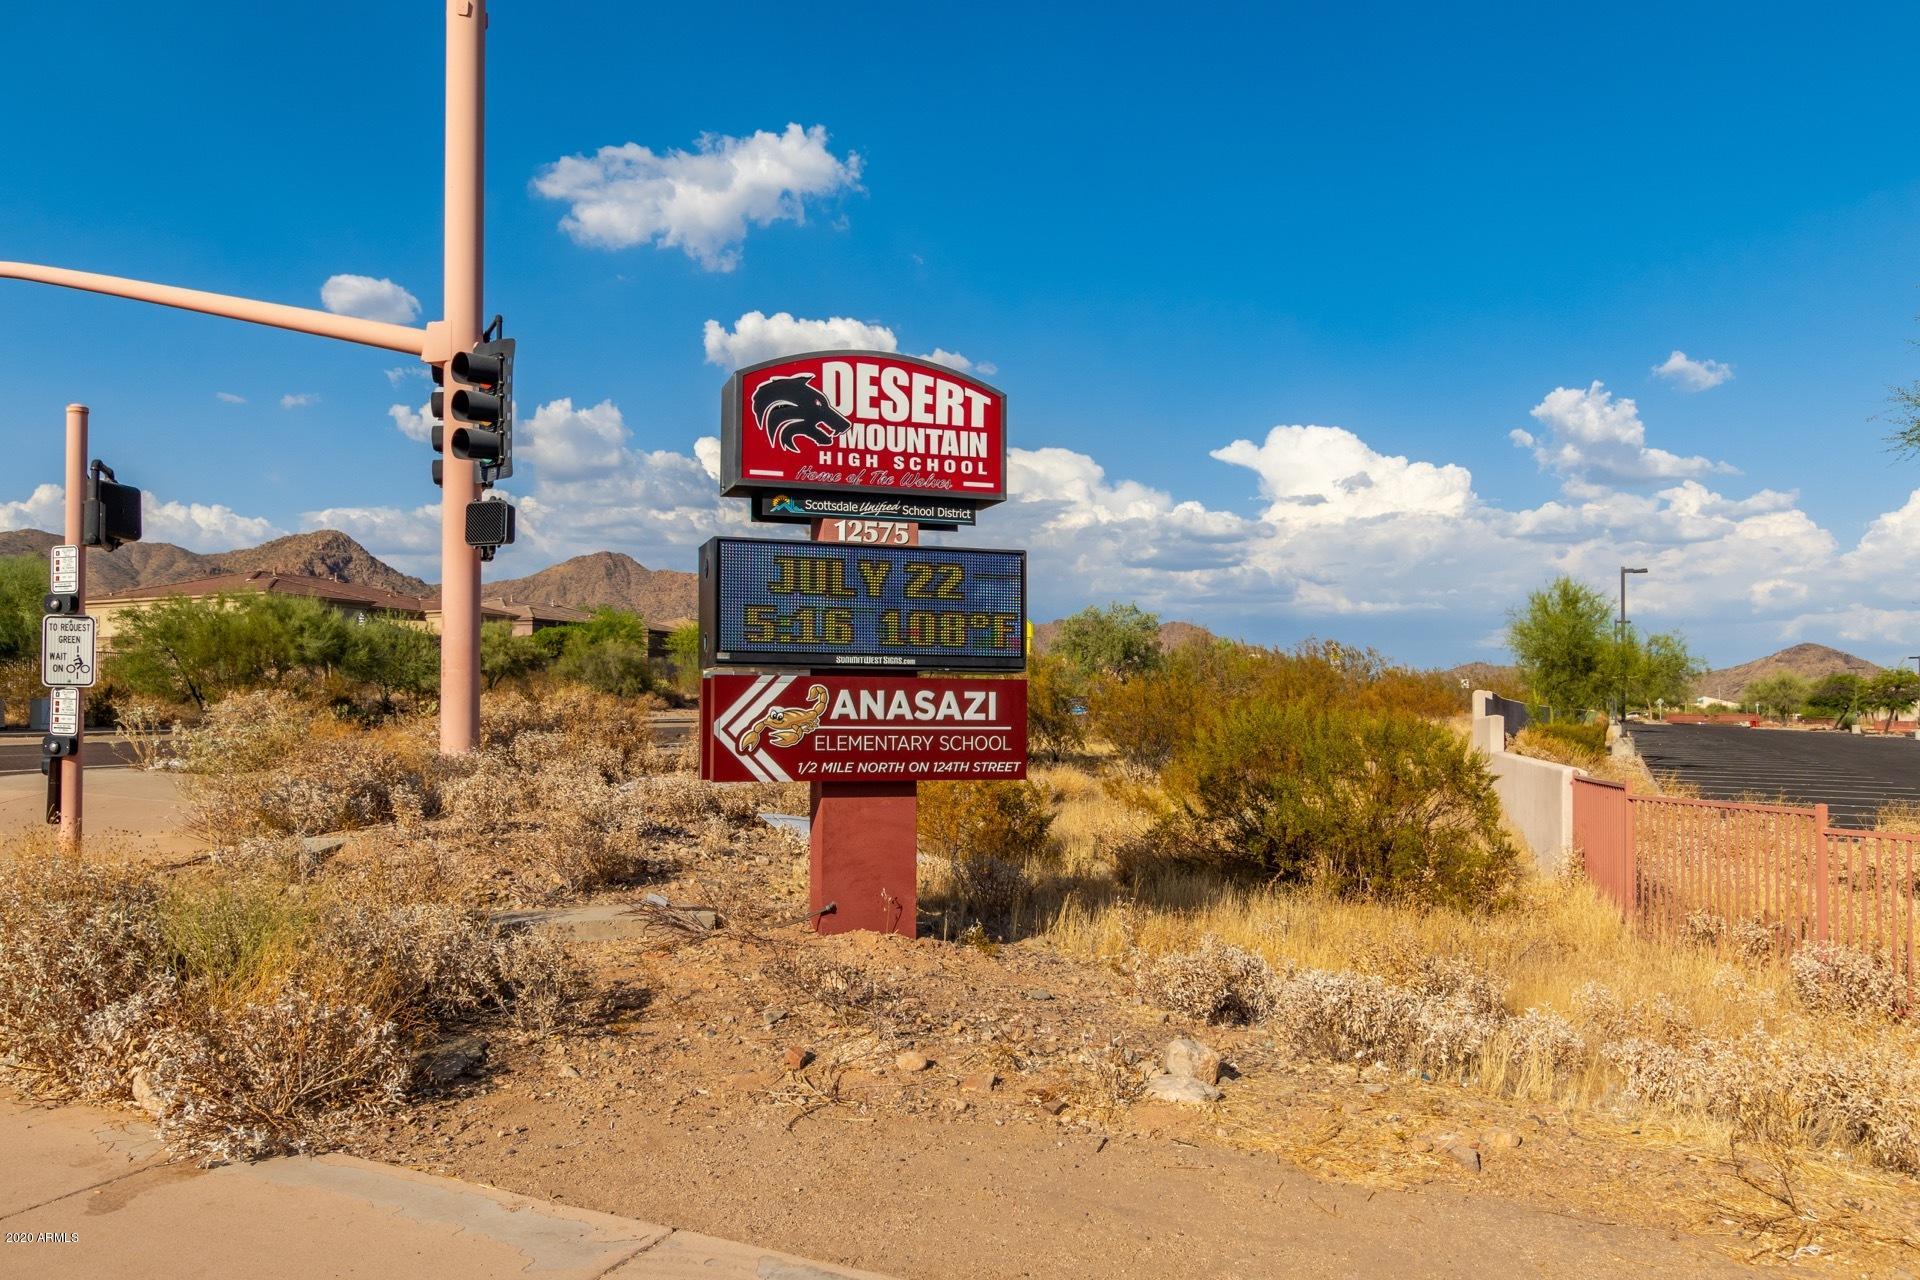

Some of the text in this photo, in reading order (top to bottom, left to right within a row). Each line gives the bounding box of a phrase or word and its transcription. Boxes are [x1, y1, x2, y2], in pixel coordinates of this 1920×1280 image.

[822, 361, 991, 428] DESERT
[839, 423, 988, 458] MOUNTAIN
[819, 450, 988, 475] HIGH SCHOOL
[795, 466, 953, 490] Home of The Wolves
[805, 500, 971, 519] Scottsdale Unified School District
[834, 519, 910, 545] 12575
[769, 557, 965, 599] JULY 22
[49, 623, 90, 632] TO REQUEST
[747, 606, 853, 644] 5:16
[58, 635, 81, 643] GREEN
[49, 652, 67, 661] WAIT
[52, 664, 64, 672] ON
[830, 689, 996, 721] ANASAZI
[815, 735, 1012, 751] ELEMENTARY SCHOOL
[798, 761, 1021, 774] 1/2 MILE NORTH ON 124TH STREET
